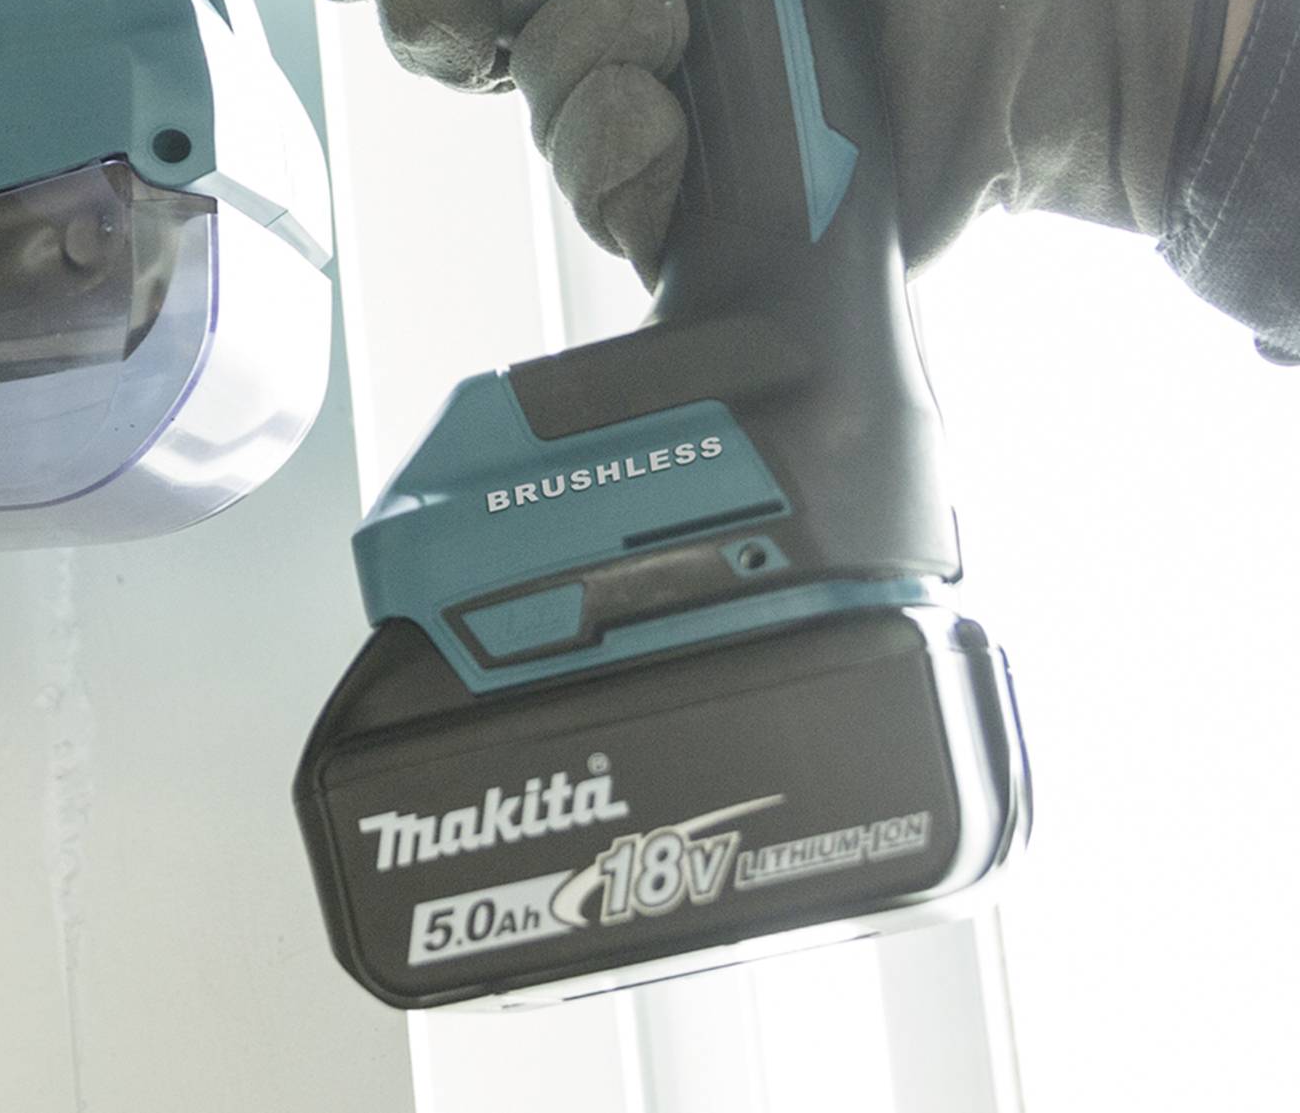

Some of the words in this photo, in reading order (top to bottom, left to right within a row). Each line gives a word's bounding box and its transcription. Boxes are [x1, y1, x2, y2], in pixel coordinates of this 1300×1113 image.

[486, 436, 724, 513] BRUSHLESS
[422, 897, 542, 953] 5.0Ah
[736, 811, 929, 887] LITHIUM-ION
